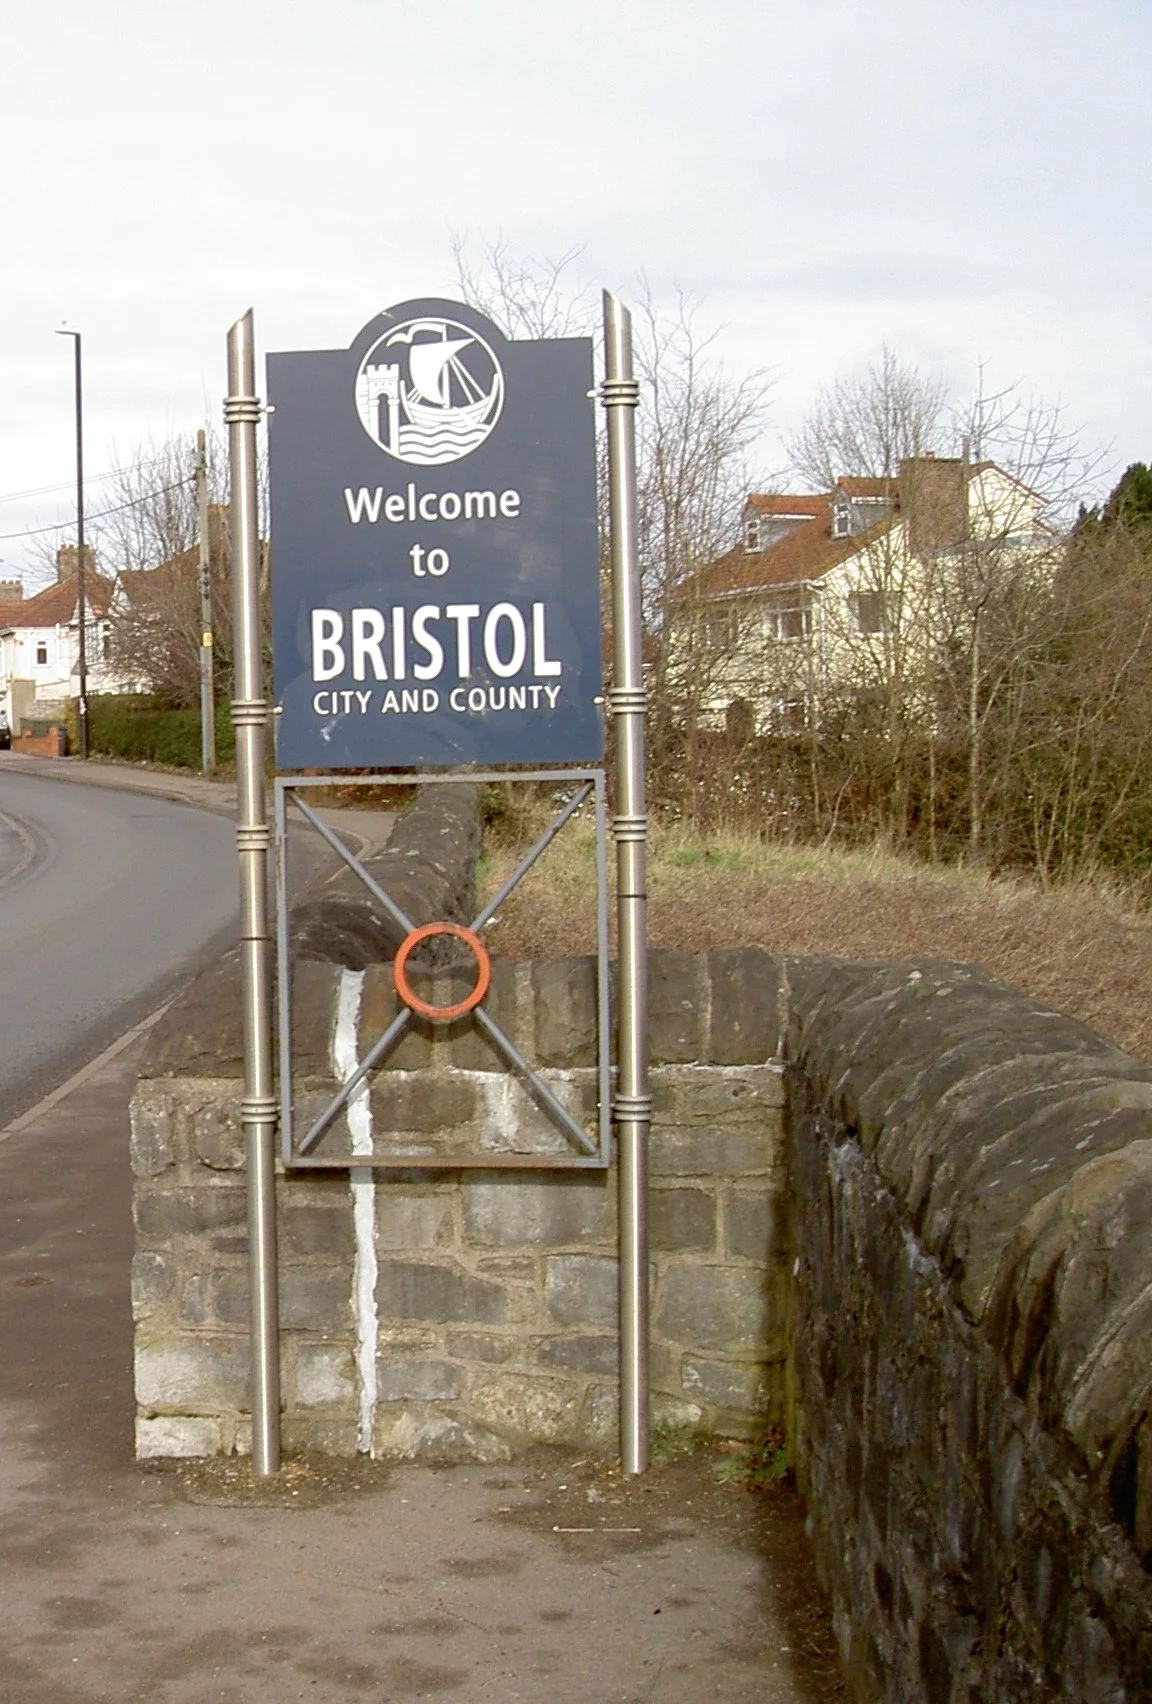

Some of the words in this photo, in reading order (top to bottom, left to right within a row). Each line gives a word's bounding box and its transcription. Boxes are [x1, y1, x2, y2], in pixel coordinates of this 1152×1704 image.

[343, 483, 522, 525] Welcome
[408, 543, 451, 577] to
[310, 601, 563, 683] BRISTOL
[312, 690, 373, 716] CITY
[380, 688, 440, 715] AND
[449, 684, 562, 712] COUNTY
